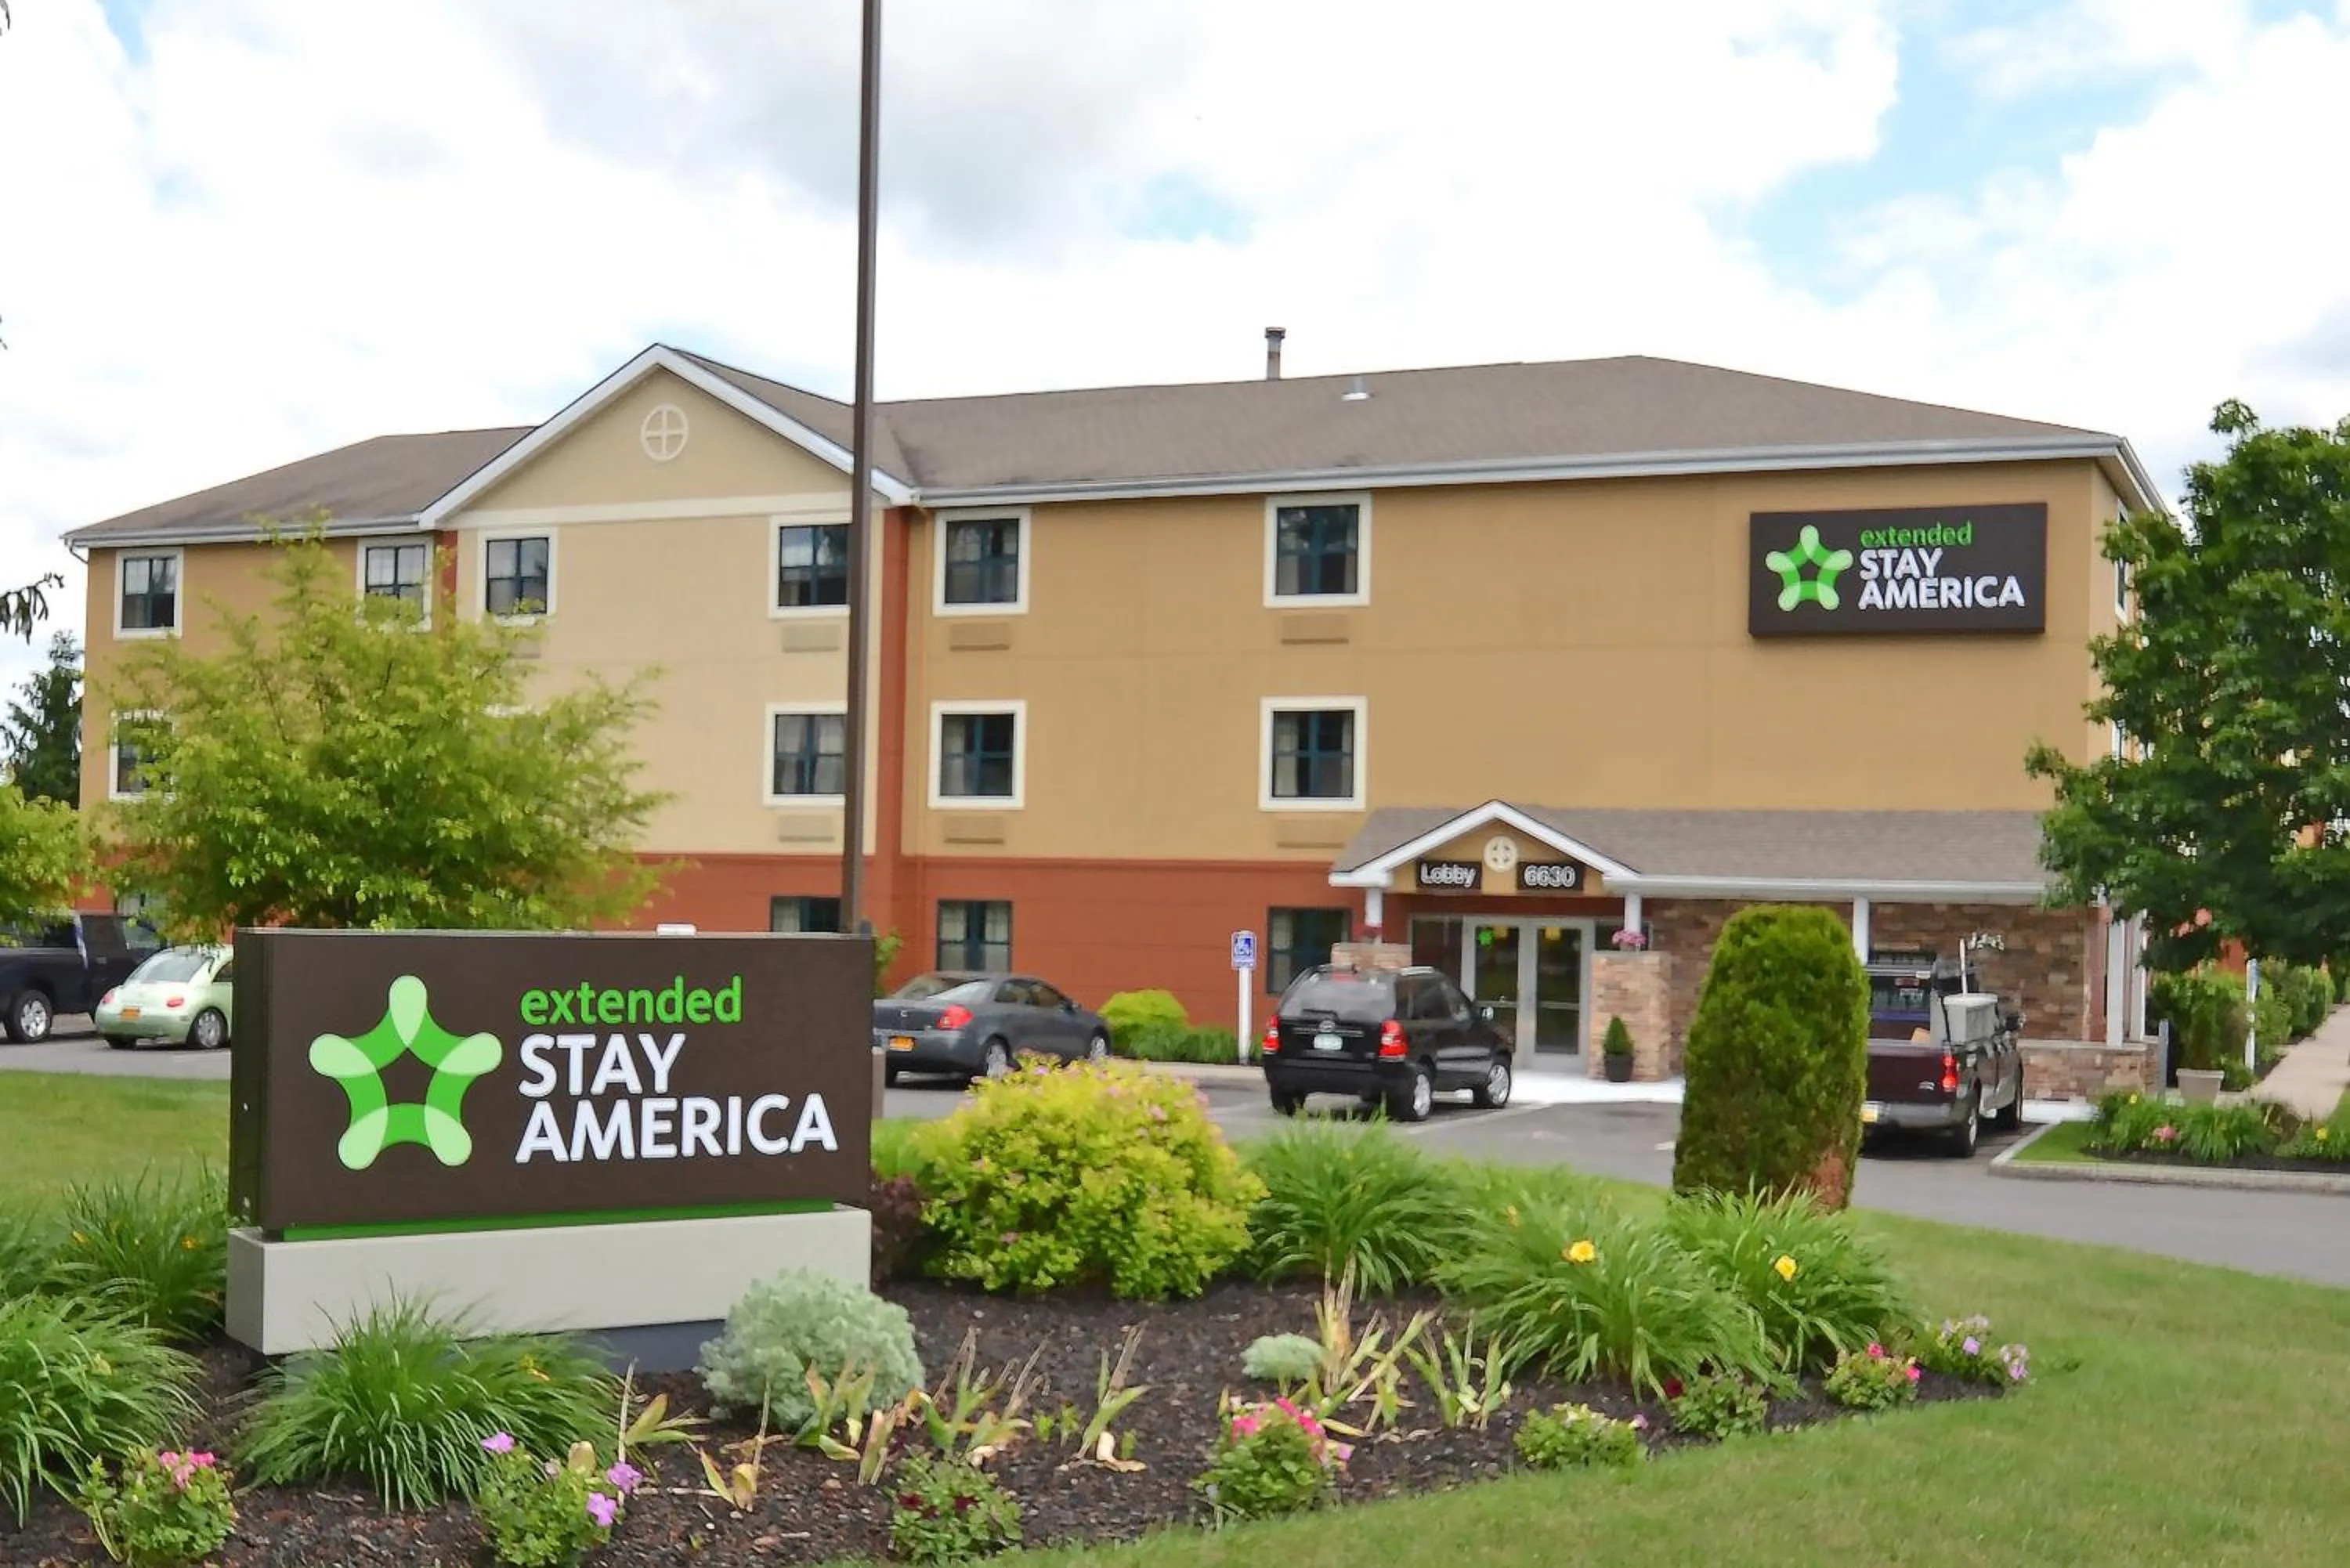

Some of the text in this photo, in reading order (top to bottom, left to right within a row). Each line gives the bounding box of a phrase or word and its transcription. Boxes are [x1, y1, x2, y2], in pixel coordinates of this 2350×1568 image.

[1861, 521, 1972, 547] extended
[1860, 548, 1943, 580] STAY
[1858, 576, 2026, 610] AMERICA
[1421, 863, 1476, 887] Lobby
[1524, 865, 1576, 887] 6630
[521, 976, 742, 1025] extended
[518, 1033, 686, 1097] STAY
[515, 1093, 839, 1164] AMERICA
